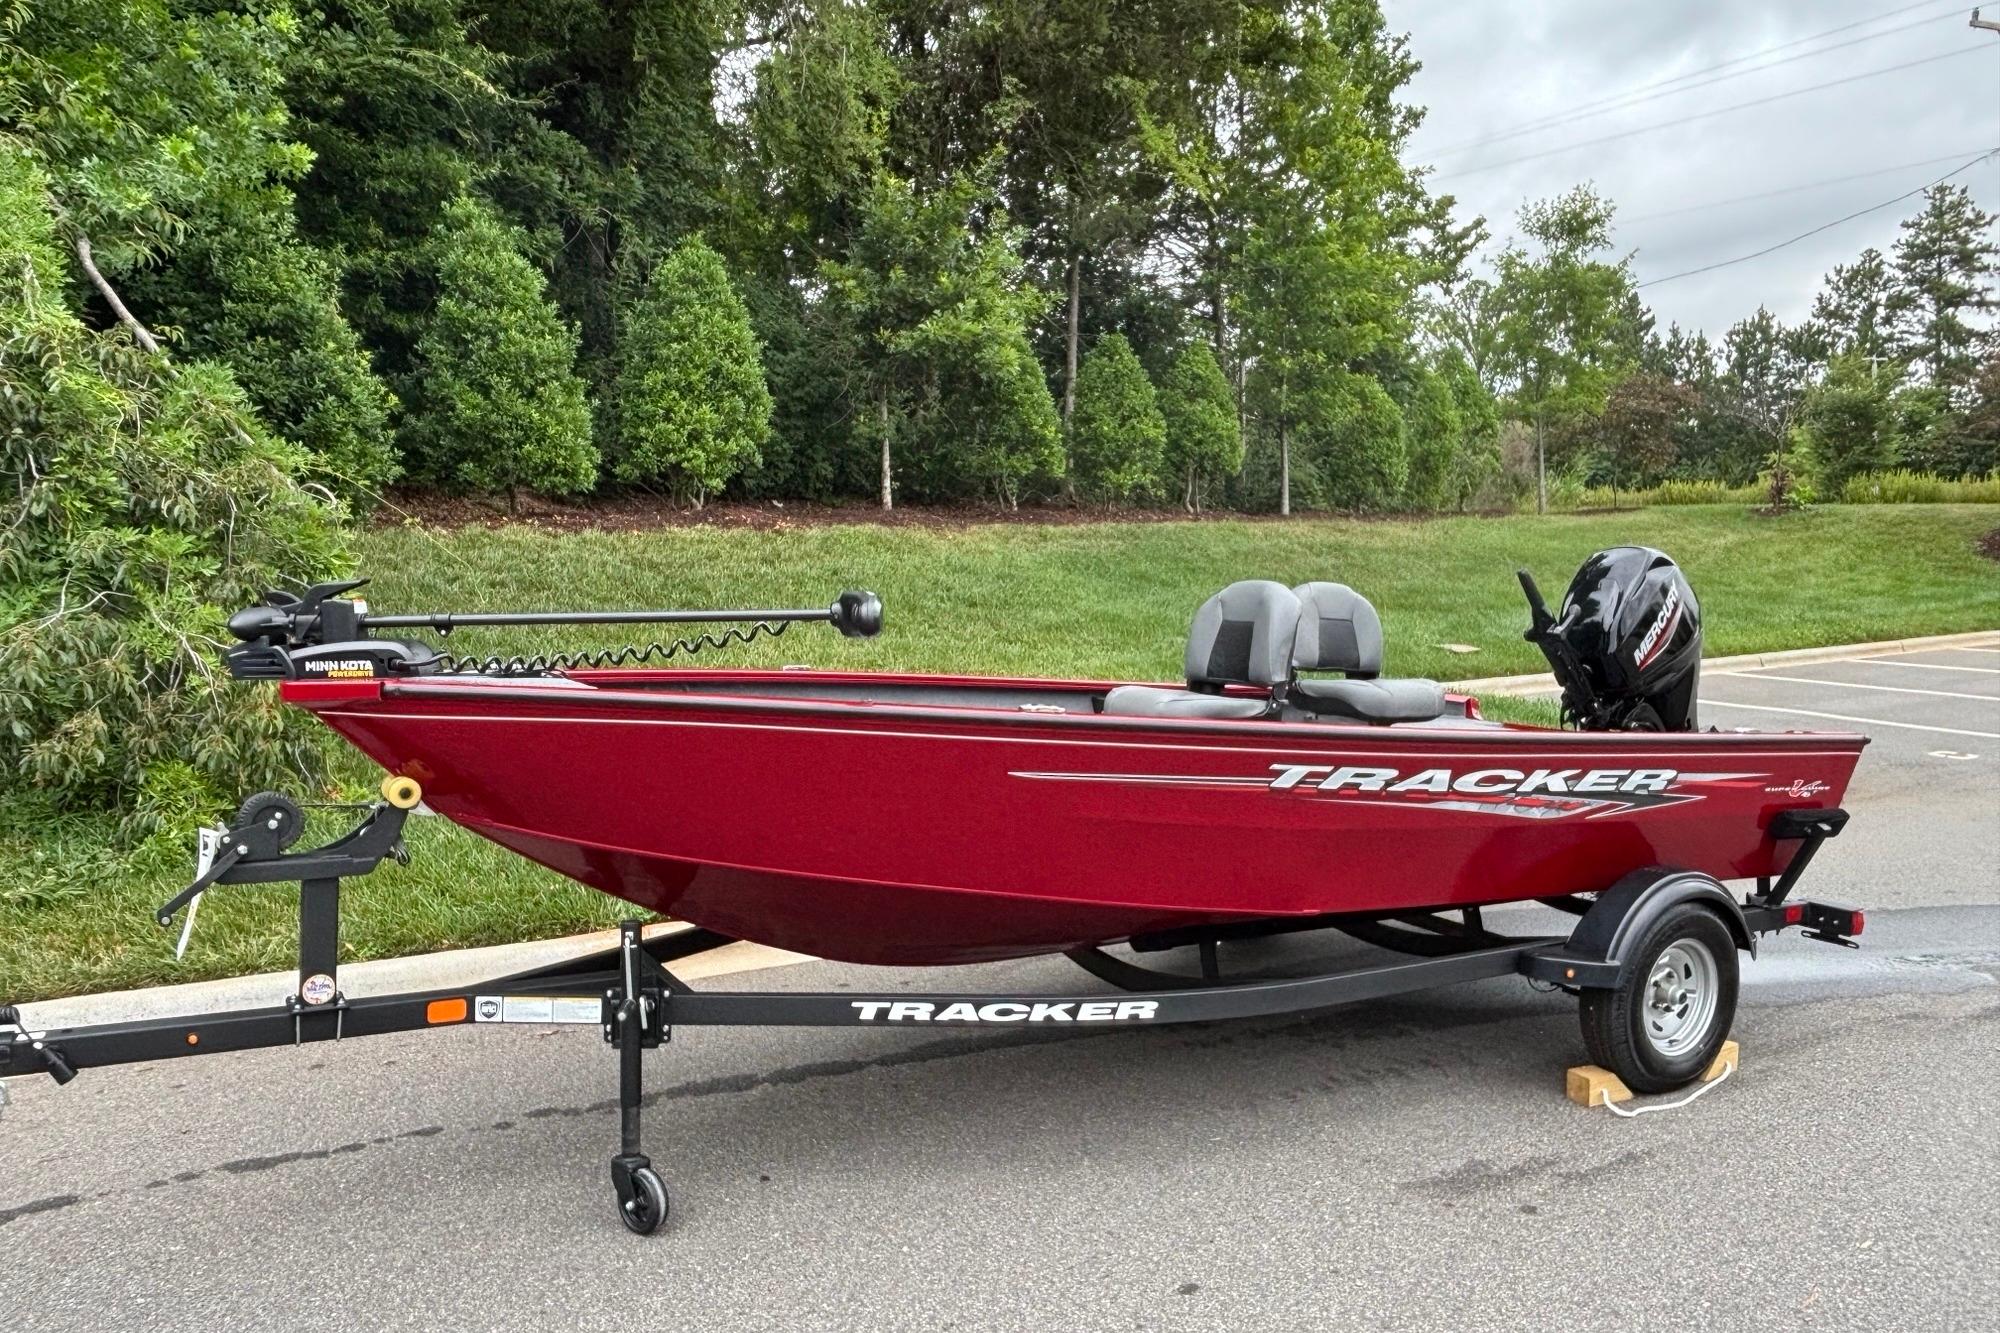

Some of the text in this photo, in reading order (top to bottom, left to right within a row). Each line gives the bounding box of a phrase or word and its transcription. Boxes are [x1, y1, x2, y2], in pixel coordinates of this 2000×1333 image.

[305, 660, 373, 671] MINN KOTA
[1268, 763, 1679, 793] TRACKER
[851, 1000, 1159, 1022] TRACKER
